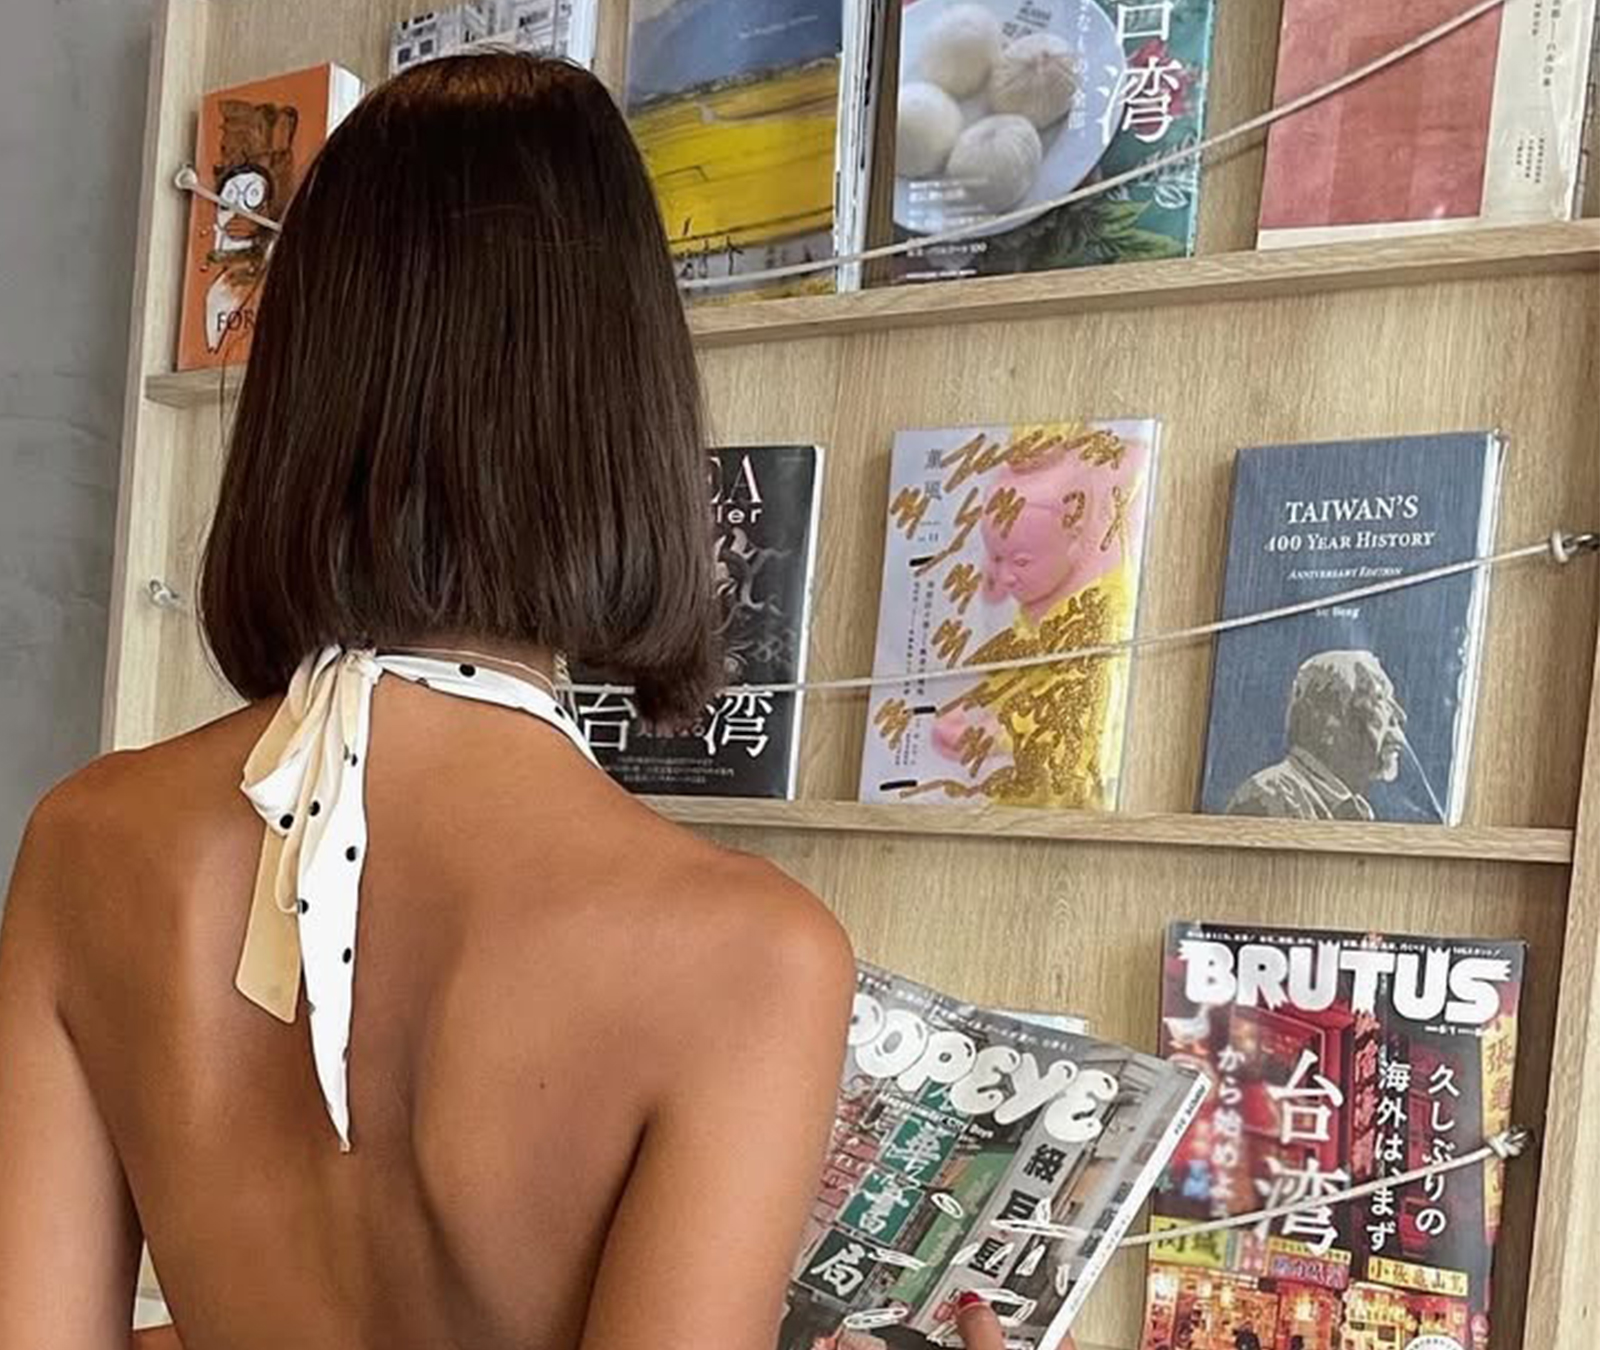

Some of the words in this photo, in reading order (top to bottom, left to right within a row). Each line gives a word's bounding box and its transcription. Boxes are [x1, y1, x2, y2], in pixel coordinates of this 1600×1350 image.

[1264, 534, 1302, 552] 400
[1285, 494, 1420, 525] TAIWAN'S
[578, 684, 774, 757] 台湾
[1178, 939, 1513, 1024] BRUTUS
[1254, 1049, 1351, 1255] 台湾
